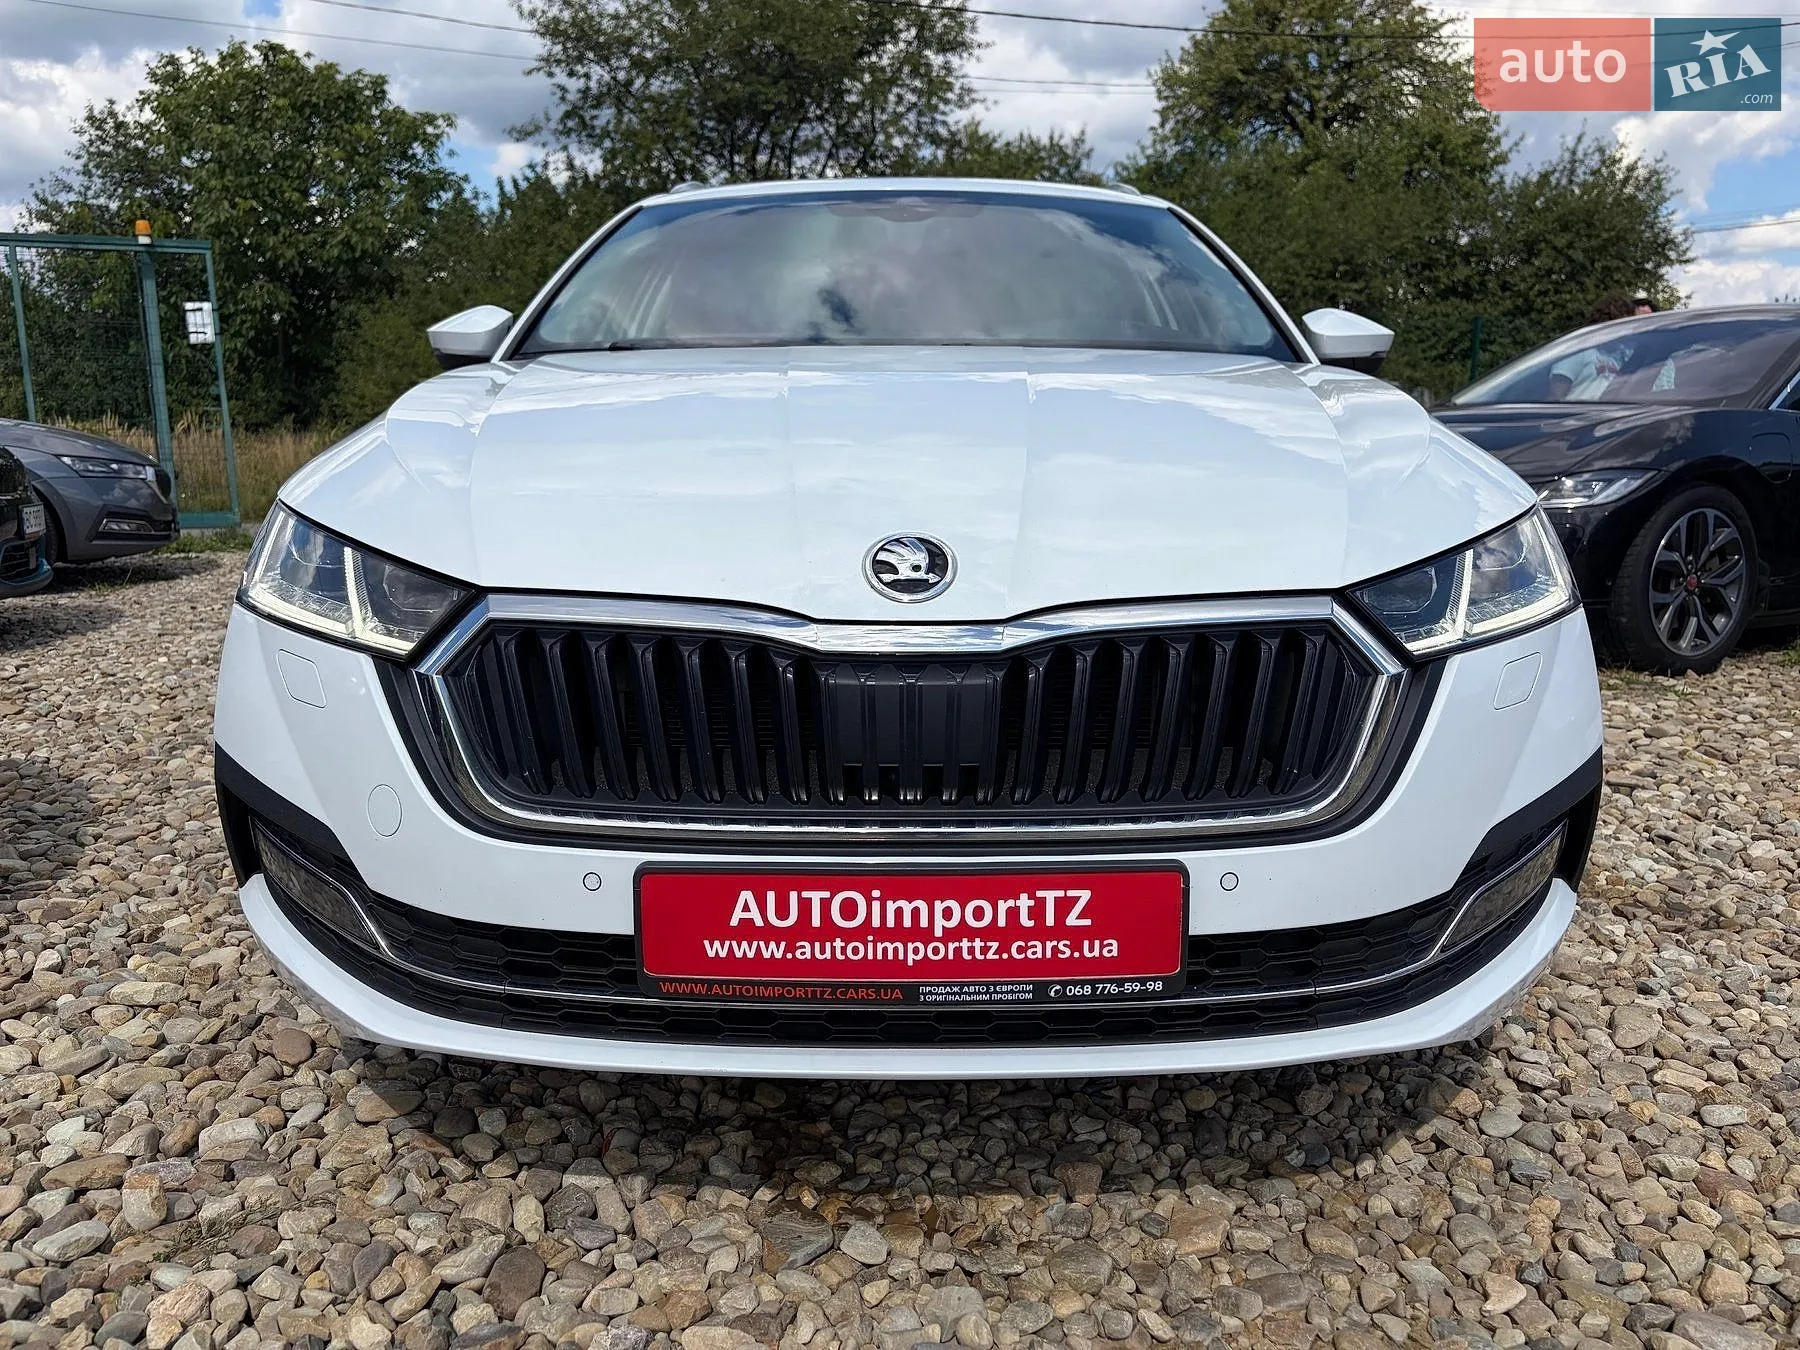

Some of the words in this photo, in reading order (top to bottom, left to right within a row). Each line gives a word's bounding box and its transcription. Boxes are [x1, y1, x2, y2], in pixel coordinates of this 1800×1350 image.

[729, 889, 1092, 937] AUTOimportTZ
[703, 936, 1119, 966] www.autoimporttz.cars.ua
[659, 981, 904, 1000] WWW.AUTOIMPORTTZ.CARS.UA
[919, 986, 960, 994] ПРОДАЖ
[962, 985, 987, 993] АВТО
[996, 984, 1034, 992] ЄВРОПИ
[925, 993, 990, 1002] ОРИГІНАЛЬНИМ
[991, 992, 1033, 1001] ПРОБІГОМ
[1066, 985, 1092, 996] 068
[1095, 981, 1163, 995] 776-59-98
